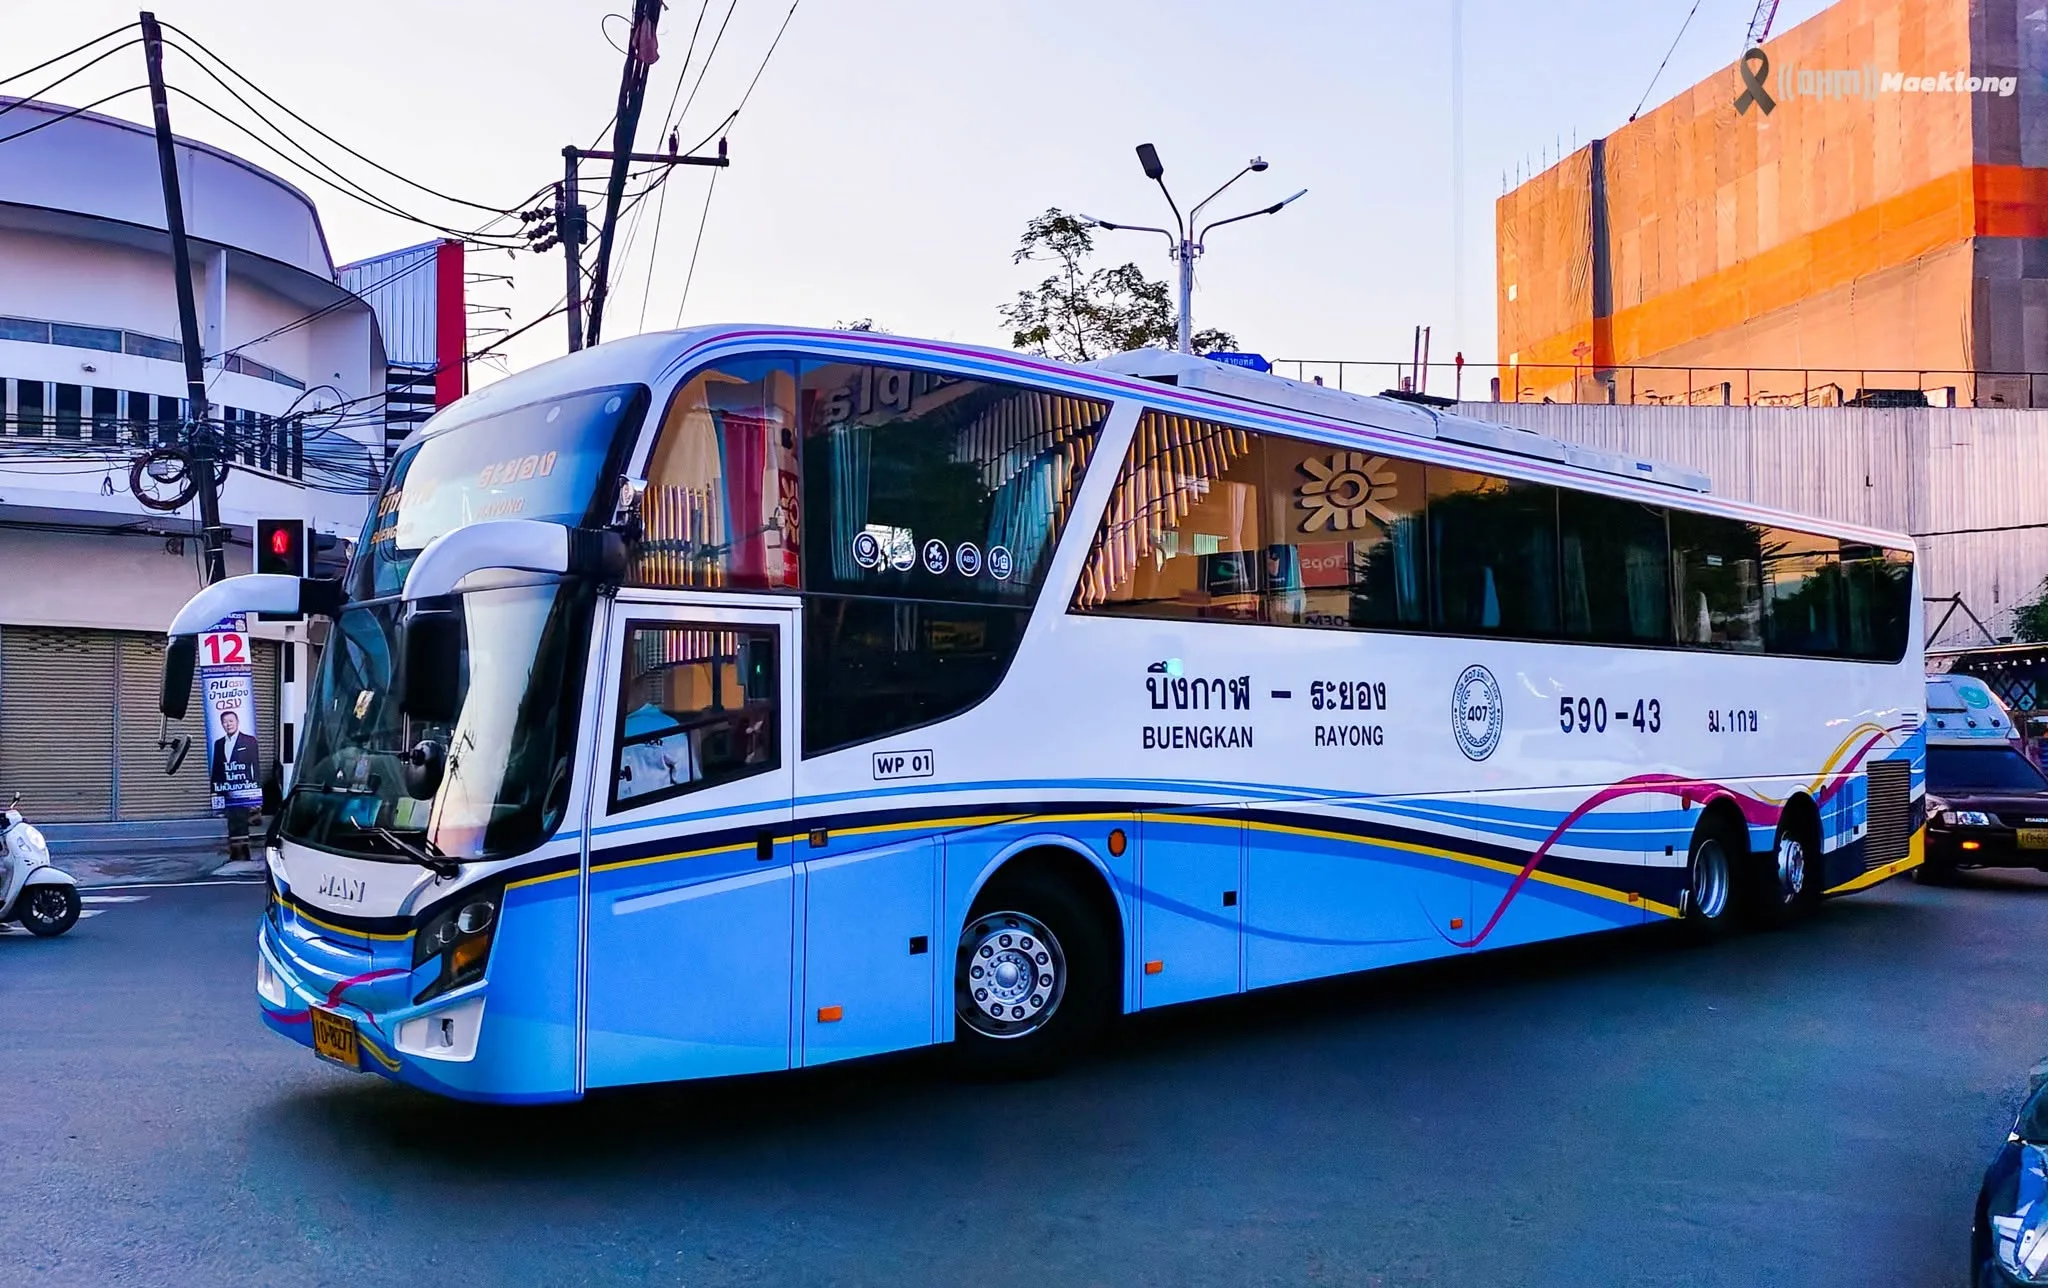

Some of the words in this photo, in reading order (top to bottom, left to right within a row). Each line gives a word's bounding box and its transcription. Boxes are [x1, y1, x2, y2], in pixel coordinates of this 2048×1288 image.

[479, 451, 557, 488] ระยอง
[930, 561, 943, 569] GPS
[963, 555, 974, 563] ABS
[204, 634, 245, 664] 12
[1146, 660, 1250, 710] บึงกาฬ
[1311, 681, 1387, 710] ระยอง
[1143, 726, 1253, 749] BUENGKAN
[1315, 726, 1383, 746] RAYONG
[877, 757, 905, 774] WP
[912, 755, 930, 772] 01
[319, 874, 366, 902] MAN
